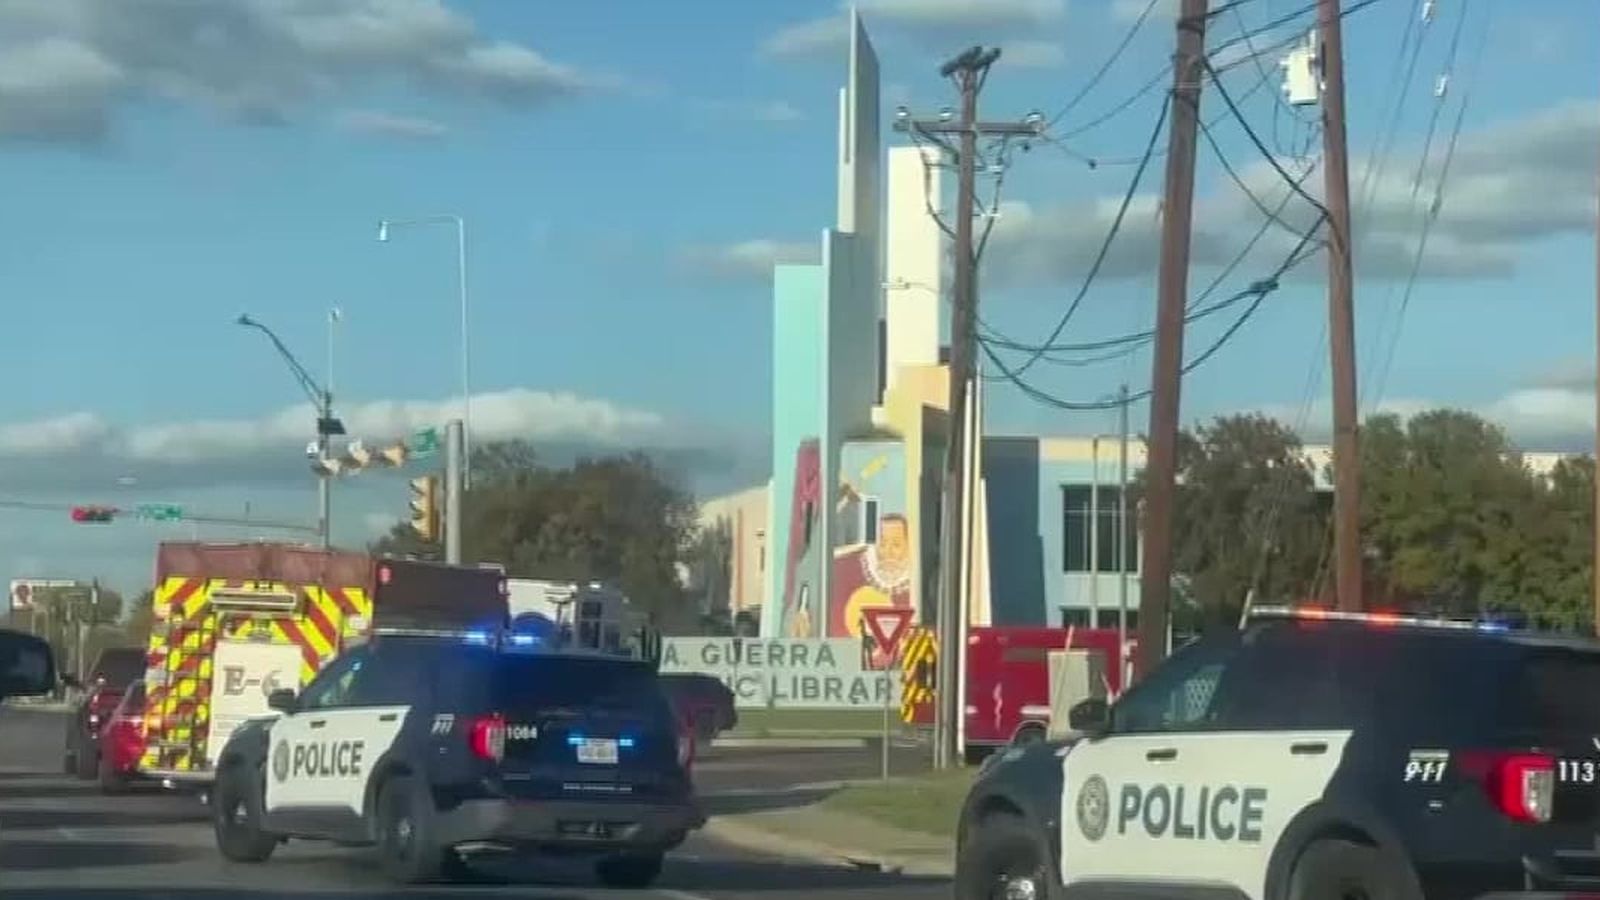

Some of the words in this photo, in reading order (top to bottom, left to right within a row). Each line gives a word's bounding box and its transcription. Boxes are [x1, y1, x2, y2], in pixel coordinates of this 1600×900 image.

[662, 642, 688, 666] A.
[701, 643, 836, 667] GUERRA
[293, 741, 364, 777] POLICE
[1558, 760, 1600, 783] 113
[1117, 783, 1267, 842] POLICE
